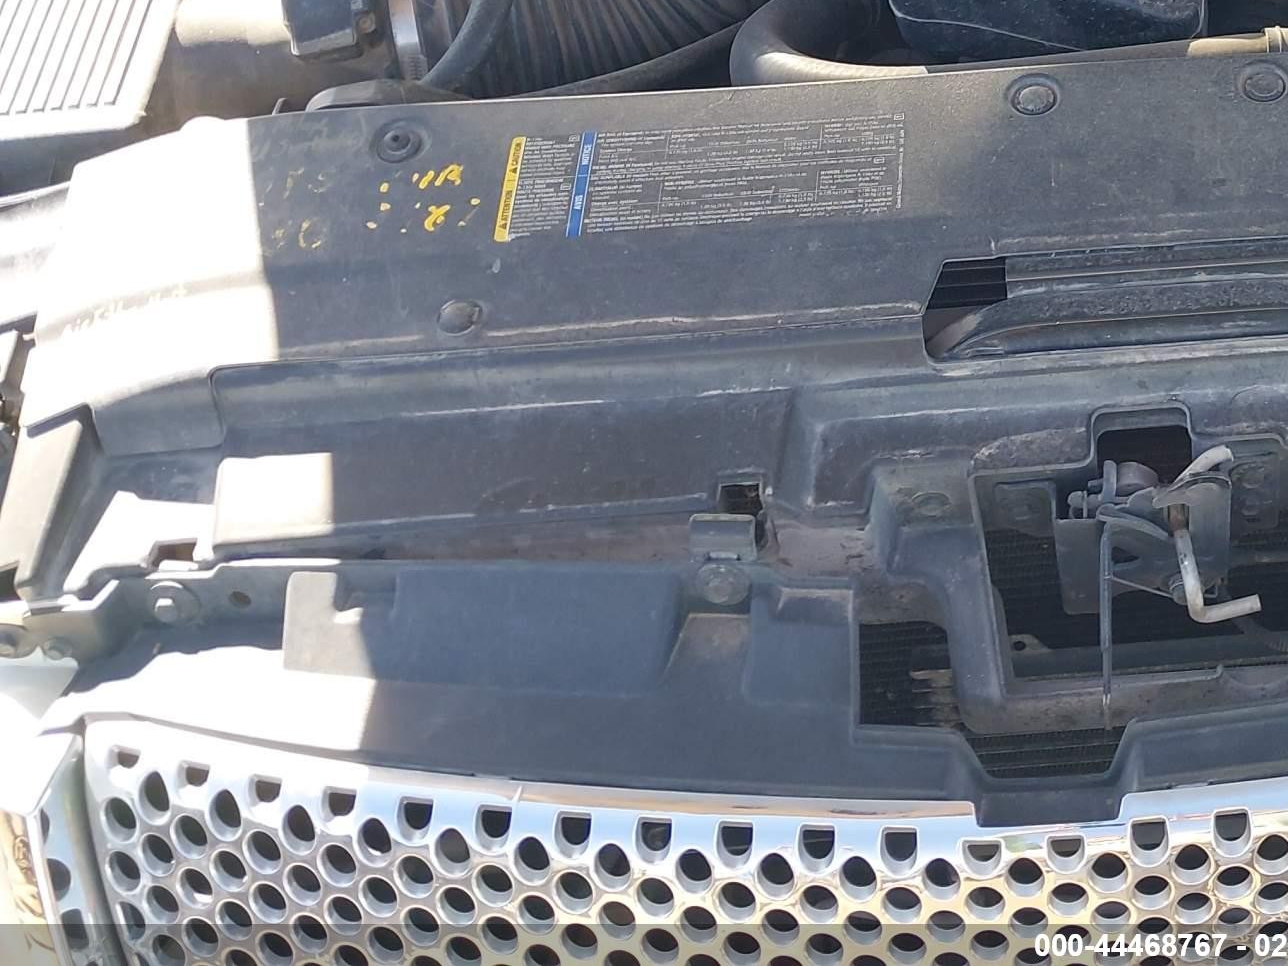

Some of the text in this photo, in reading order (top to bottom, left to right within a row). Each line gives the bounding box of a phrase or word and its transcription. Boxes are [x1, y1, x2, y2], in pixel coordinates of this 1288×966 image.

[511, 142, 522, 166] CAUTION
[582, 144, 592, 166] NOTICE
[502, 190, 512, 223] ATTENTION
[574, 194, 583, 210] AVIS
